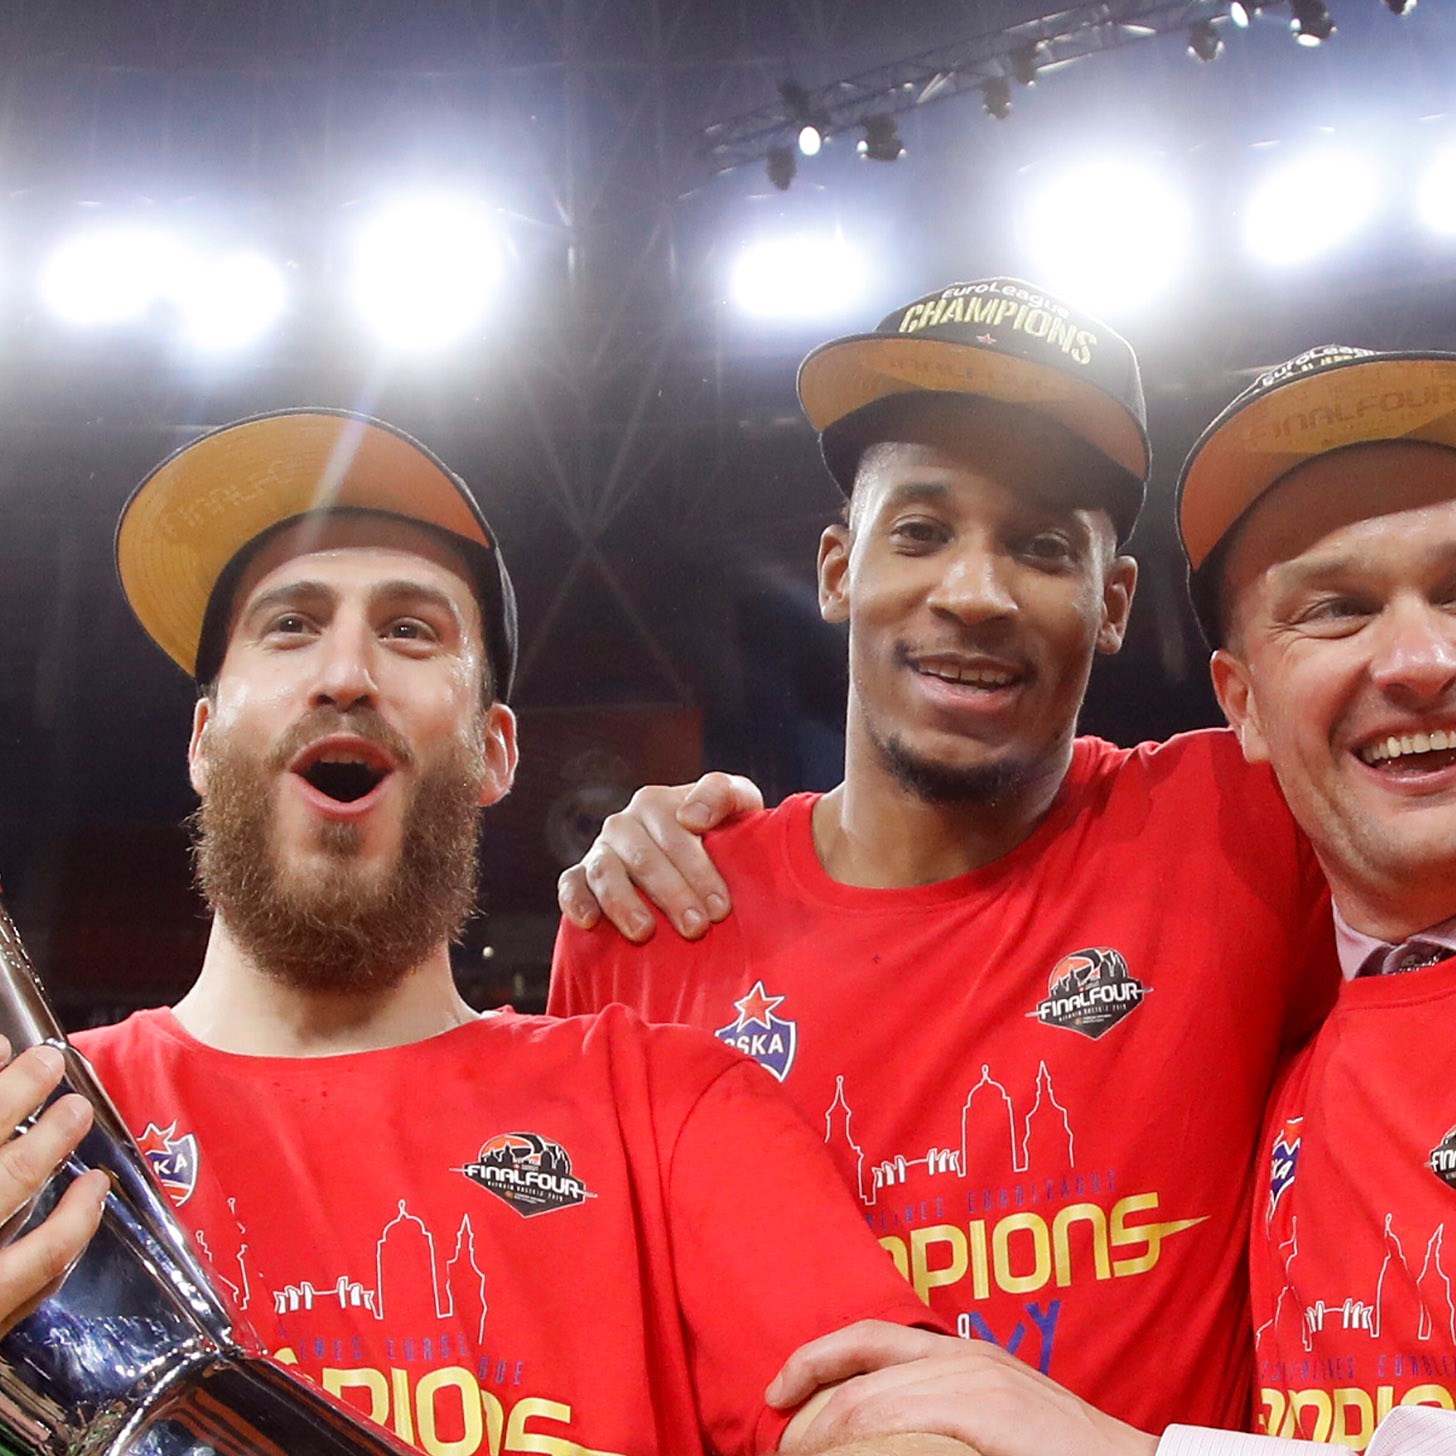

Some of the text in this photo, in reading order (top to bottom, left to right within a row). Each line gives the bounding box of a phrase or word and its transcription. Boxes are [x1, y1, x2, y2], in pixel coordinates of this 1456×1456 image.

[898, 297, 1098, 365] CHAMPIONS
[1041, 982, 1140, 1020] FINALFOUR
[153, 1154, 189, 1176] KA
[465, 1164, 581, 1199] FINALFOUR
